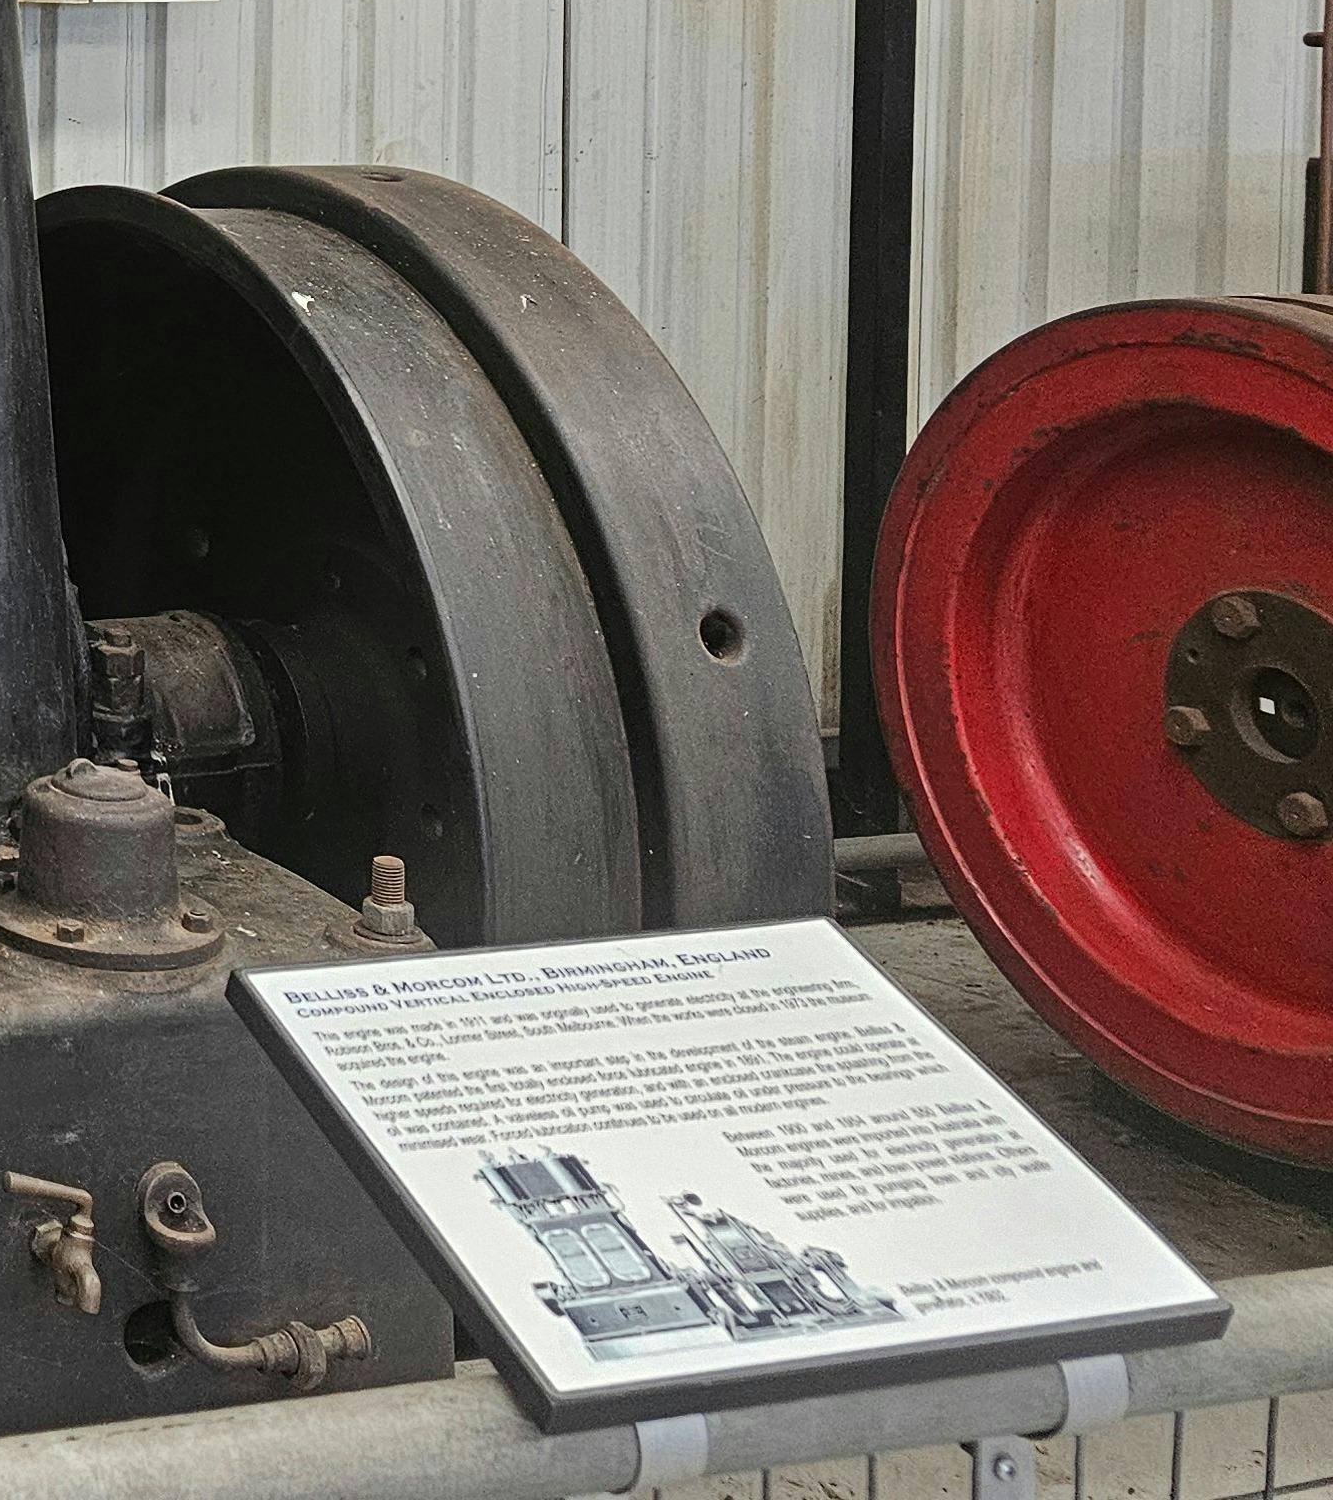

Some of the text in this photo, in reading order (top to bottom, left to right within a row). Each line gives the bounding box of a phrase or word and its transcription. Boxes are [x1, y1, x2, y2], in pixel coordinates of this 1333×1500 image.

[284, 949, 770, 1004] BELLISS & MORCOM LTD., BIRMINGHAM, ENGLAND
[297, 970, 714, 1018] COMPOUND VERTICAL ENCLOSED HIGH-SPEED ENGINE
